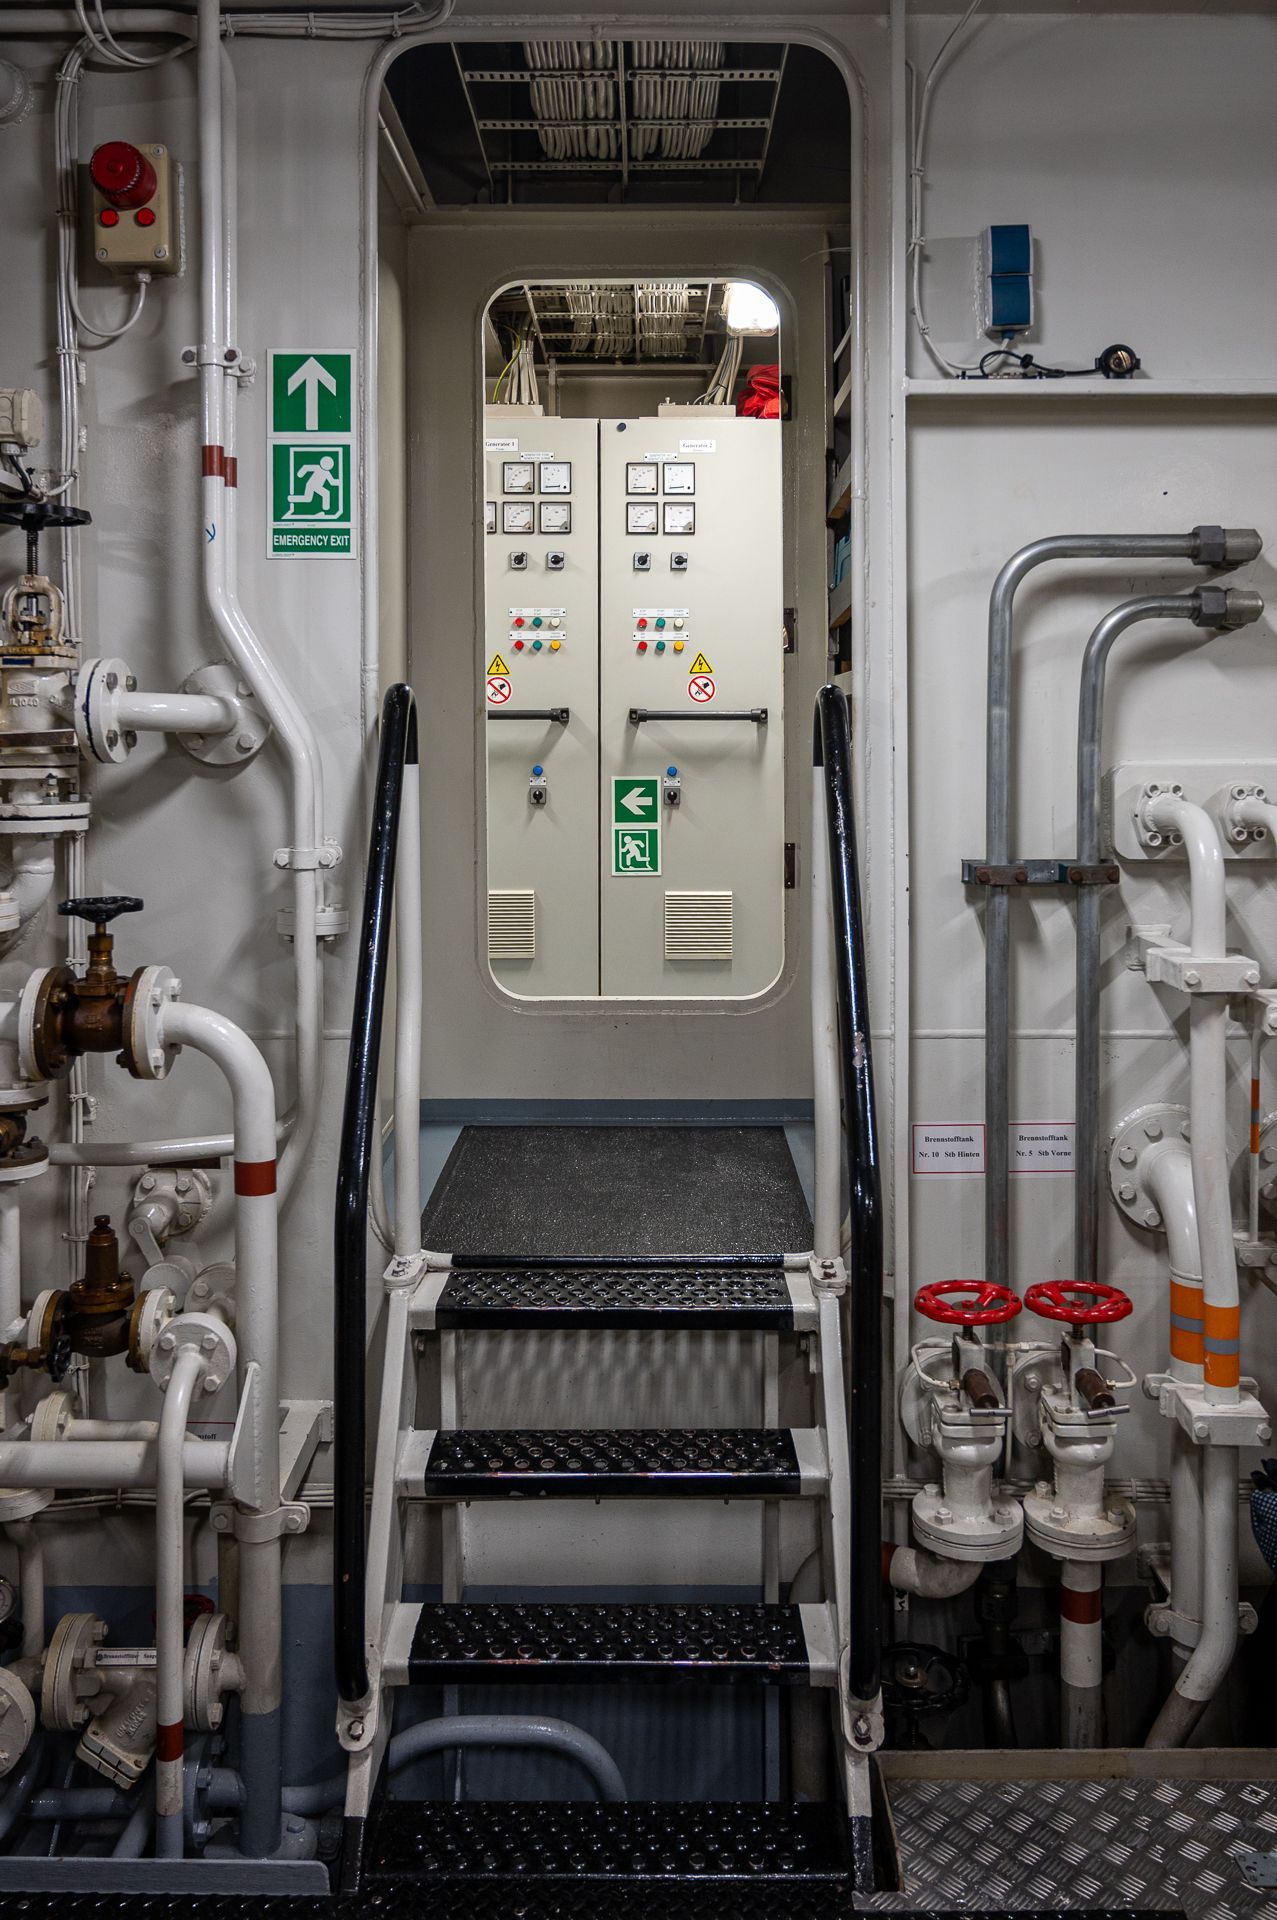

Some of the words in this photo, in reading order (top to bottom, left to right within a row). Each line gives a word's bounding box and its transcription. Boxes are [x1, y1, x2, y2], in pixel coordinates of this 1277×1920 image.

[273, 535, 328, 546] EMERGENCY
[330, 535, 350, 546] EXIT
[1018, 1134, 1068, 1142] Brennstofftank
